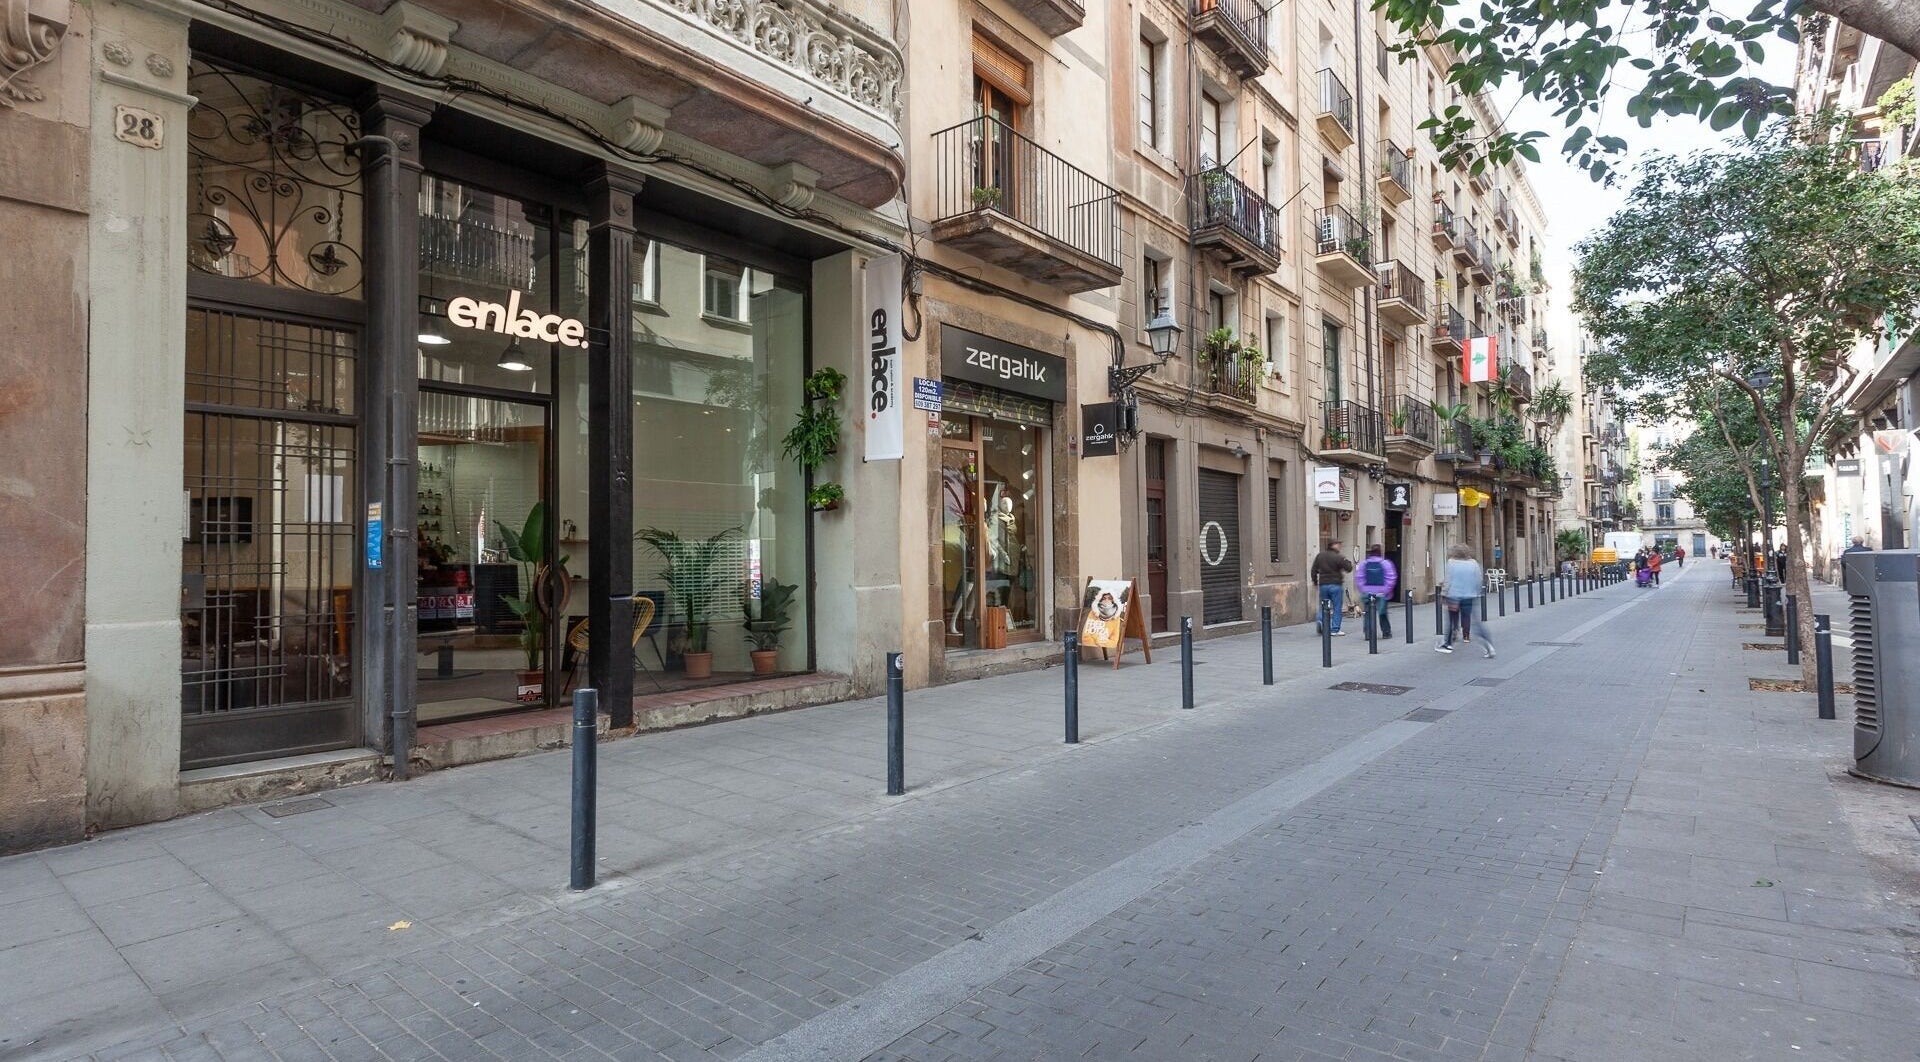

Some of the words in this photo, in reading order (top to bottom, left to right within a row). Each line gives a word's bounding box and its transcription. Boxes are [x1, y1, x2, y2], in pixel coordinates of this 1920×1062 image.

[122, 113, 155, 140] 28
[447, 289, 589, 349] enlace.
[871, 308, 896, 419] enlace.
[965, 346, 1047, 383] zergatik
[914, 392, 942, 402] DISPONIBLE
[918, 378, 938, 389] LOCAL
